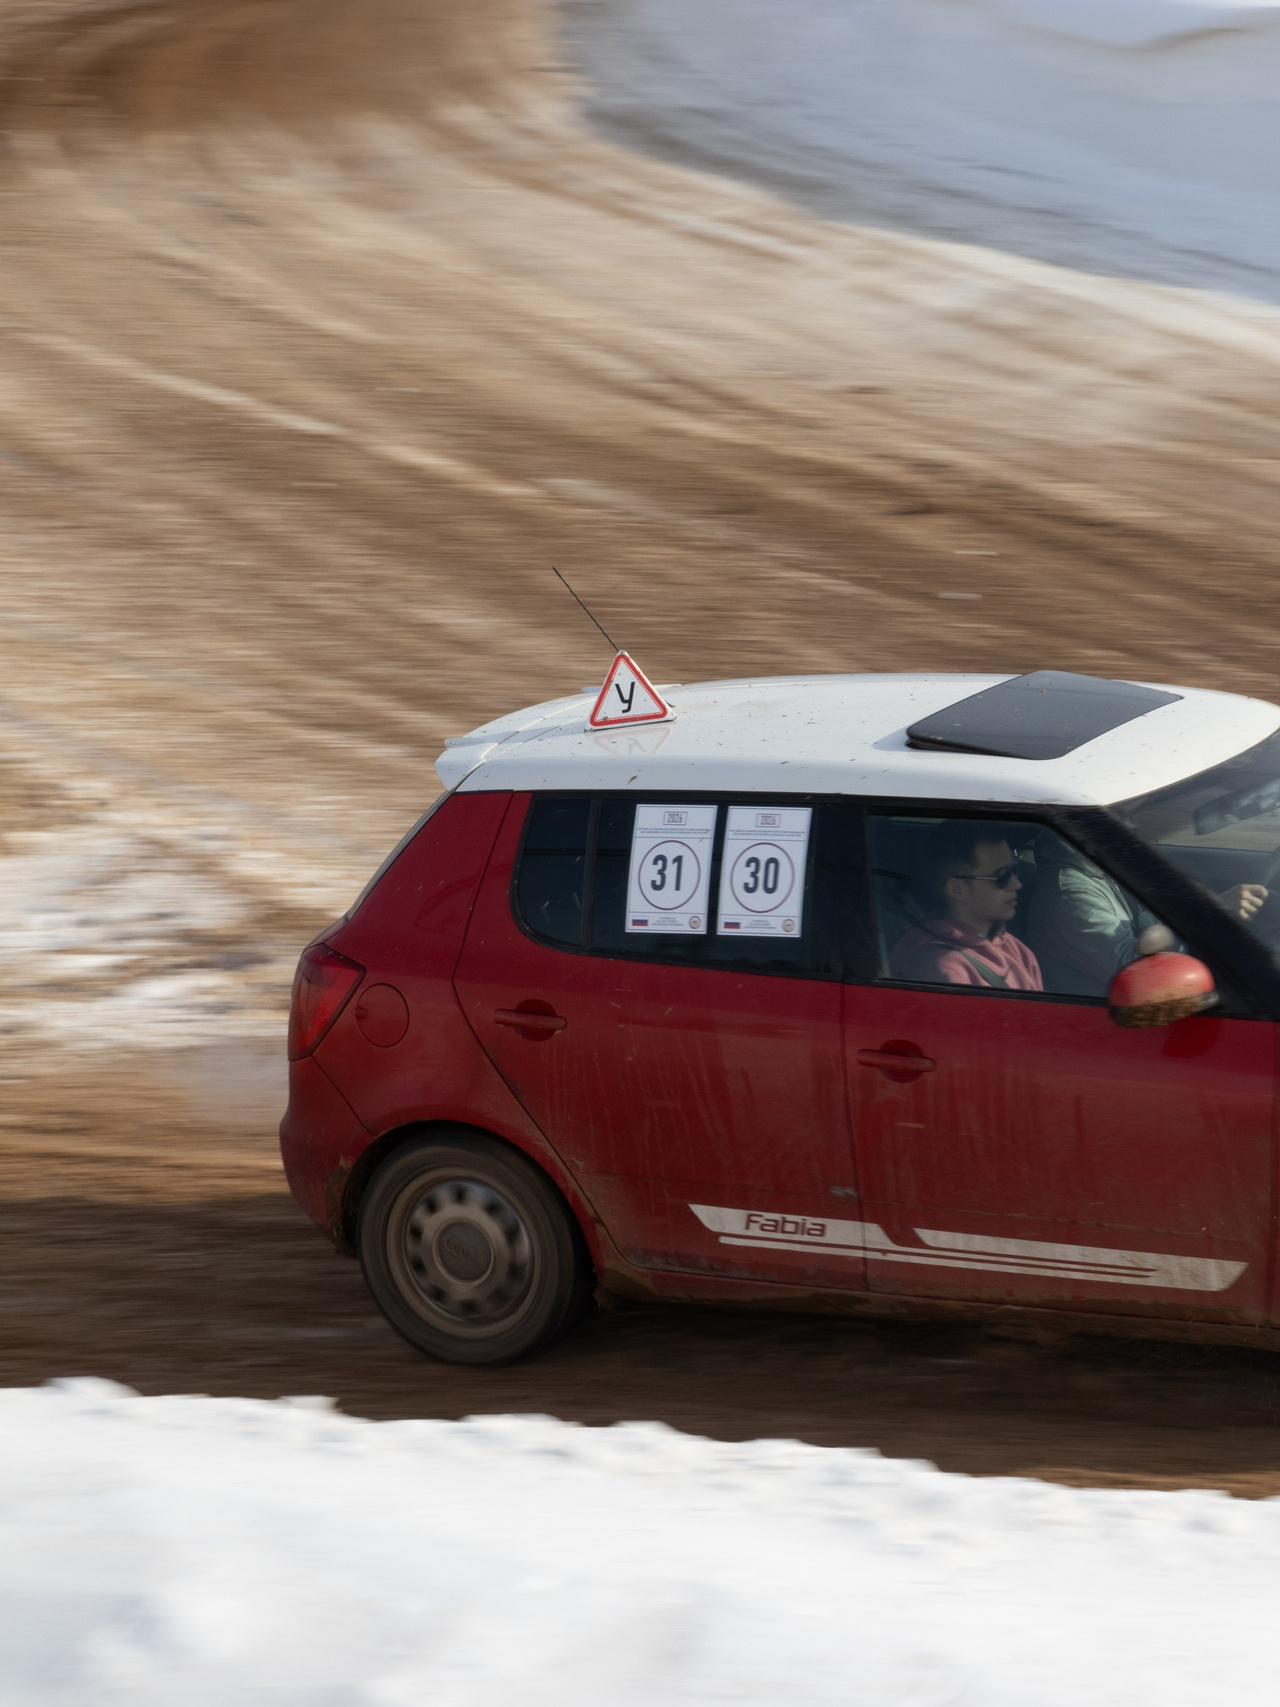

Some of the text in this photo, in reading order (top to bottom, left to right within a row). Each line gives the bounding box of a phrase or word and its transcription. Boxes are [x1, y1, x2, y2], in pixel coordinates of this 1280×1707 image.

[650, 854, 684, 891] 31
[743, 856, 780, 894] 30
[744, 1212, 827, 1238] Fabia
